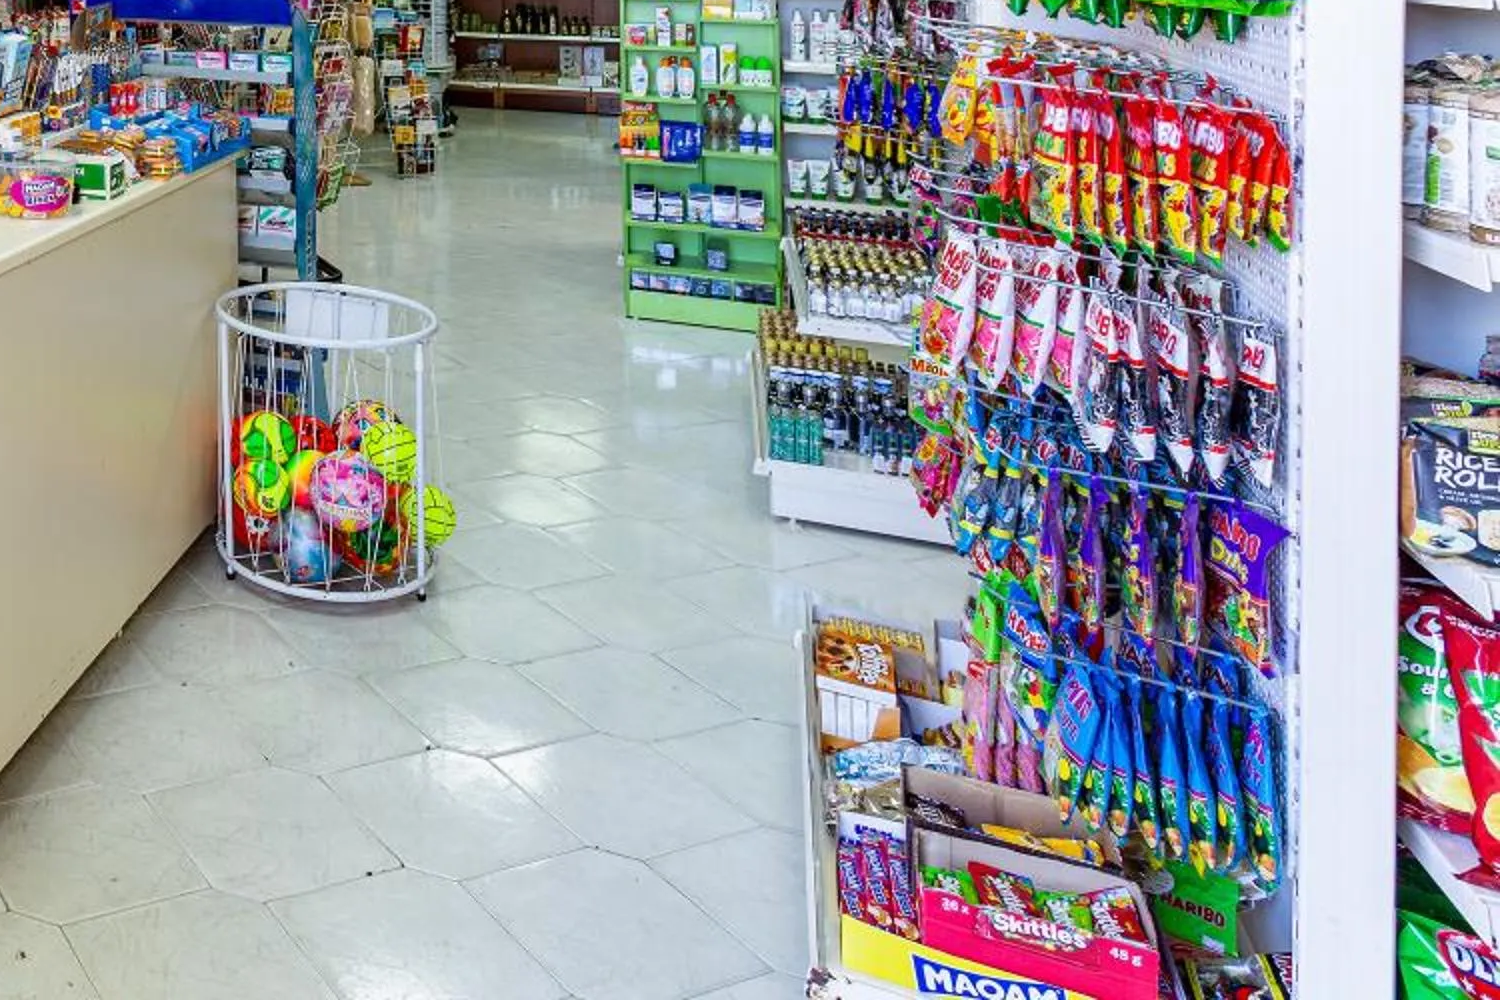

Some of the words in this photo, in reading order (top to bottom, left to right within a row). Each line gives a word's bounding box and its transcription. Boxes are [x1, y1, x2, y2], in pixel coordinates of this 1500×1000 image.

[1435, 447, 1500, 473] RICE
[1164, 893, 1225, 929] HARIBO
[993, 912, 1088, 950] Skittles
[924, 964, 1055, 1000] MAOAM
